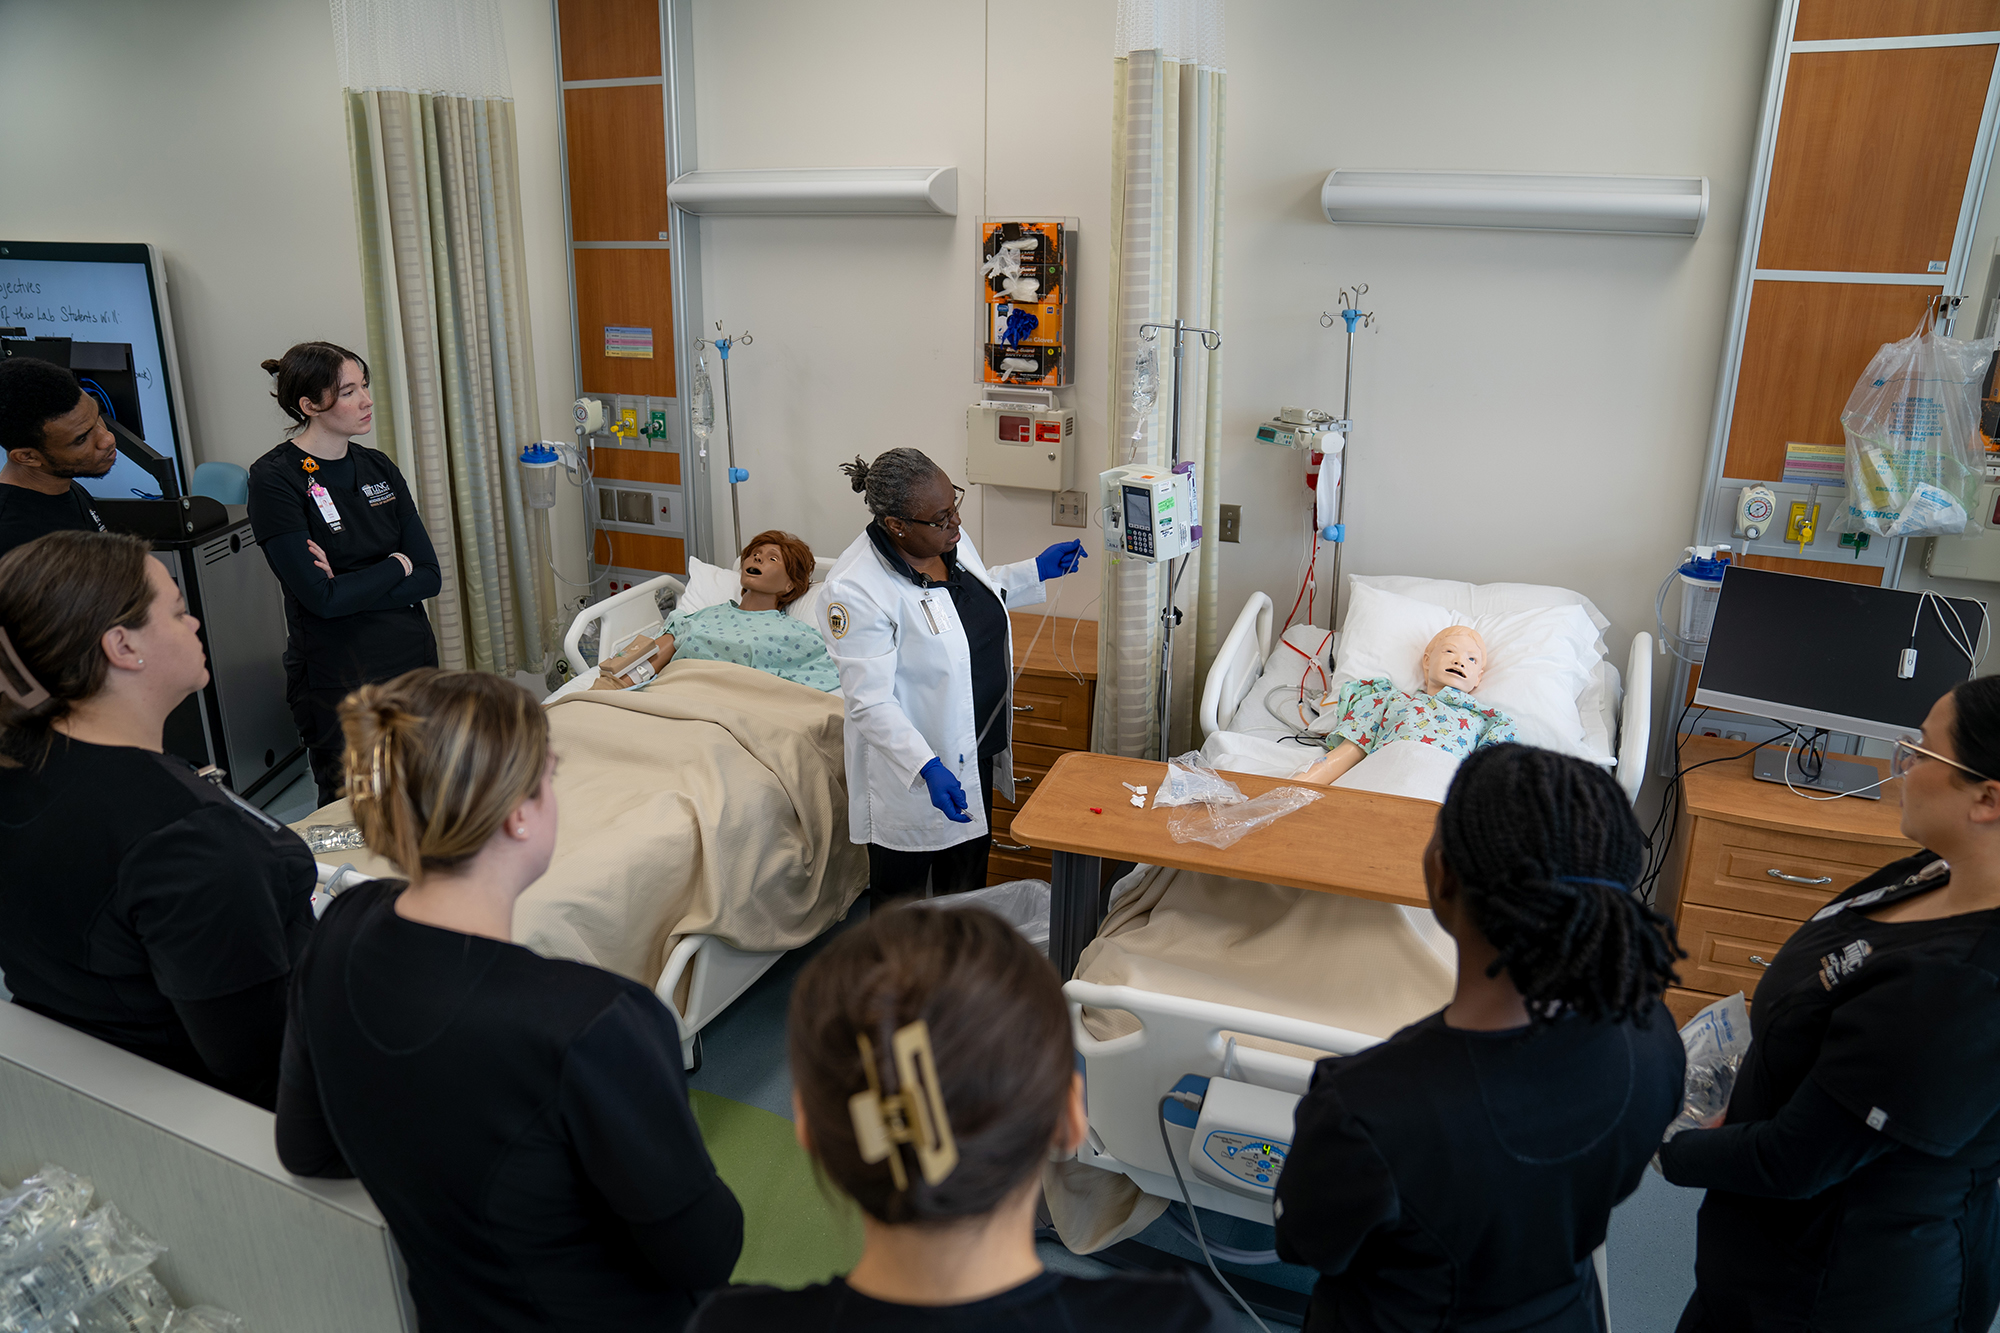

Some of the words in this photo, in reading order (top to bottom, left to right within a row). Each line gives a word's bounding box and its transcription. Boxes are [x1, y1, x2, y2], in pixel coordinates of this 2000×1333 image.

[0, 277, 42, 300] jectives
[37, 306, 55, 322] Lab
[60, 305, 98, 323] Students
[1263, 1144, 1271, 1155] 4
